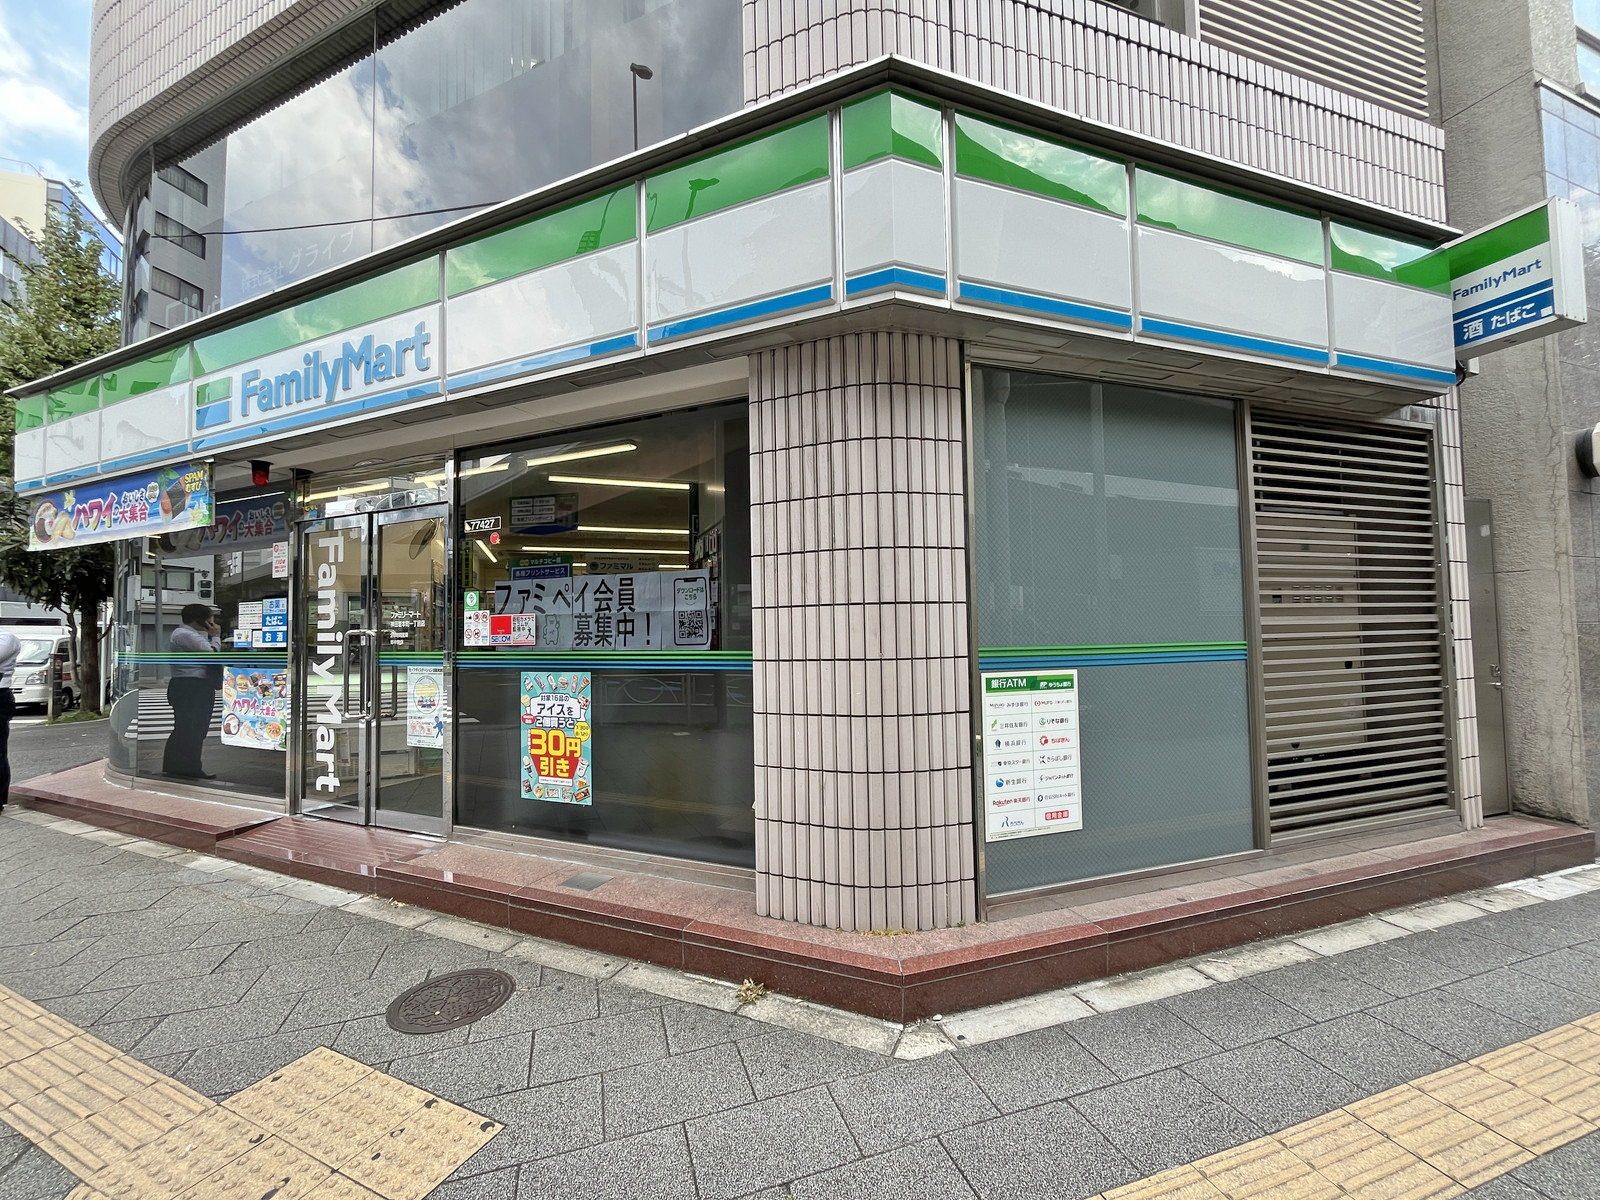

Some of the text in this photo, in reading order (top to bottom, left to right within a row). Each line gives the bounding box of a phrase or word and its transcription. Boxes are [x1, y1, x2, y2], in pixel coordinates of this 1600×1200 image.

[1453, 259, 1542, 300] FamilyMart
[1463, 303, 1537, 340] 酒 たばこ
[240, 320, 431, 417] FamilyMart
[185, 471, 204, 483] SPAM
[122, 488, 145, 504] おいしさ
[185, 482, 201, 493] むすび
[119, 501, 148, 525] 大集合
[470, 519, 495, 530] 77427
[495, 577, 636, 614] ファミペイ会員
[677, 586, 704, 594] ダウンロードは
[265, 616, 283, 626] たばこ
[391, 611, 421, 619] ファミリーマート
[574, 613, 651, 647] 募集中！
[312, 536, 344, 793] FamilyMart
[991, 678, 1027, 689] 銀行ATM
[537, 703, 574, 716] アイスを
[530, 728, 581, 758] 30円
[539, 757, 570, 777] 引き
